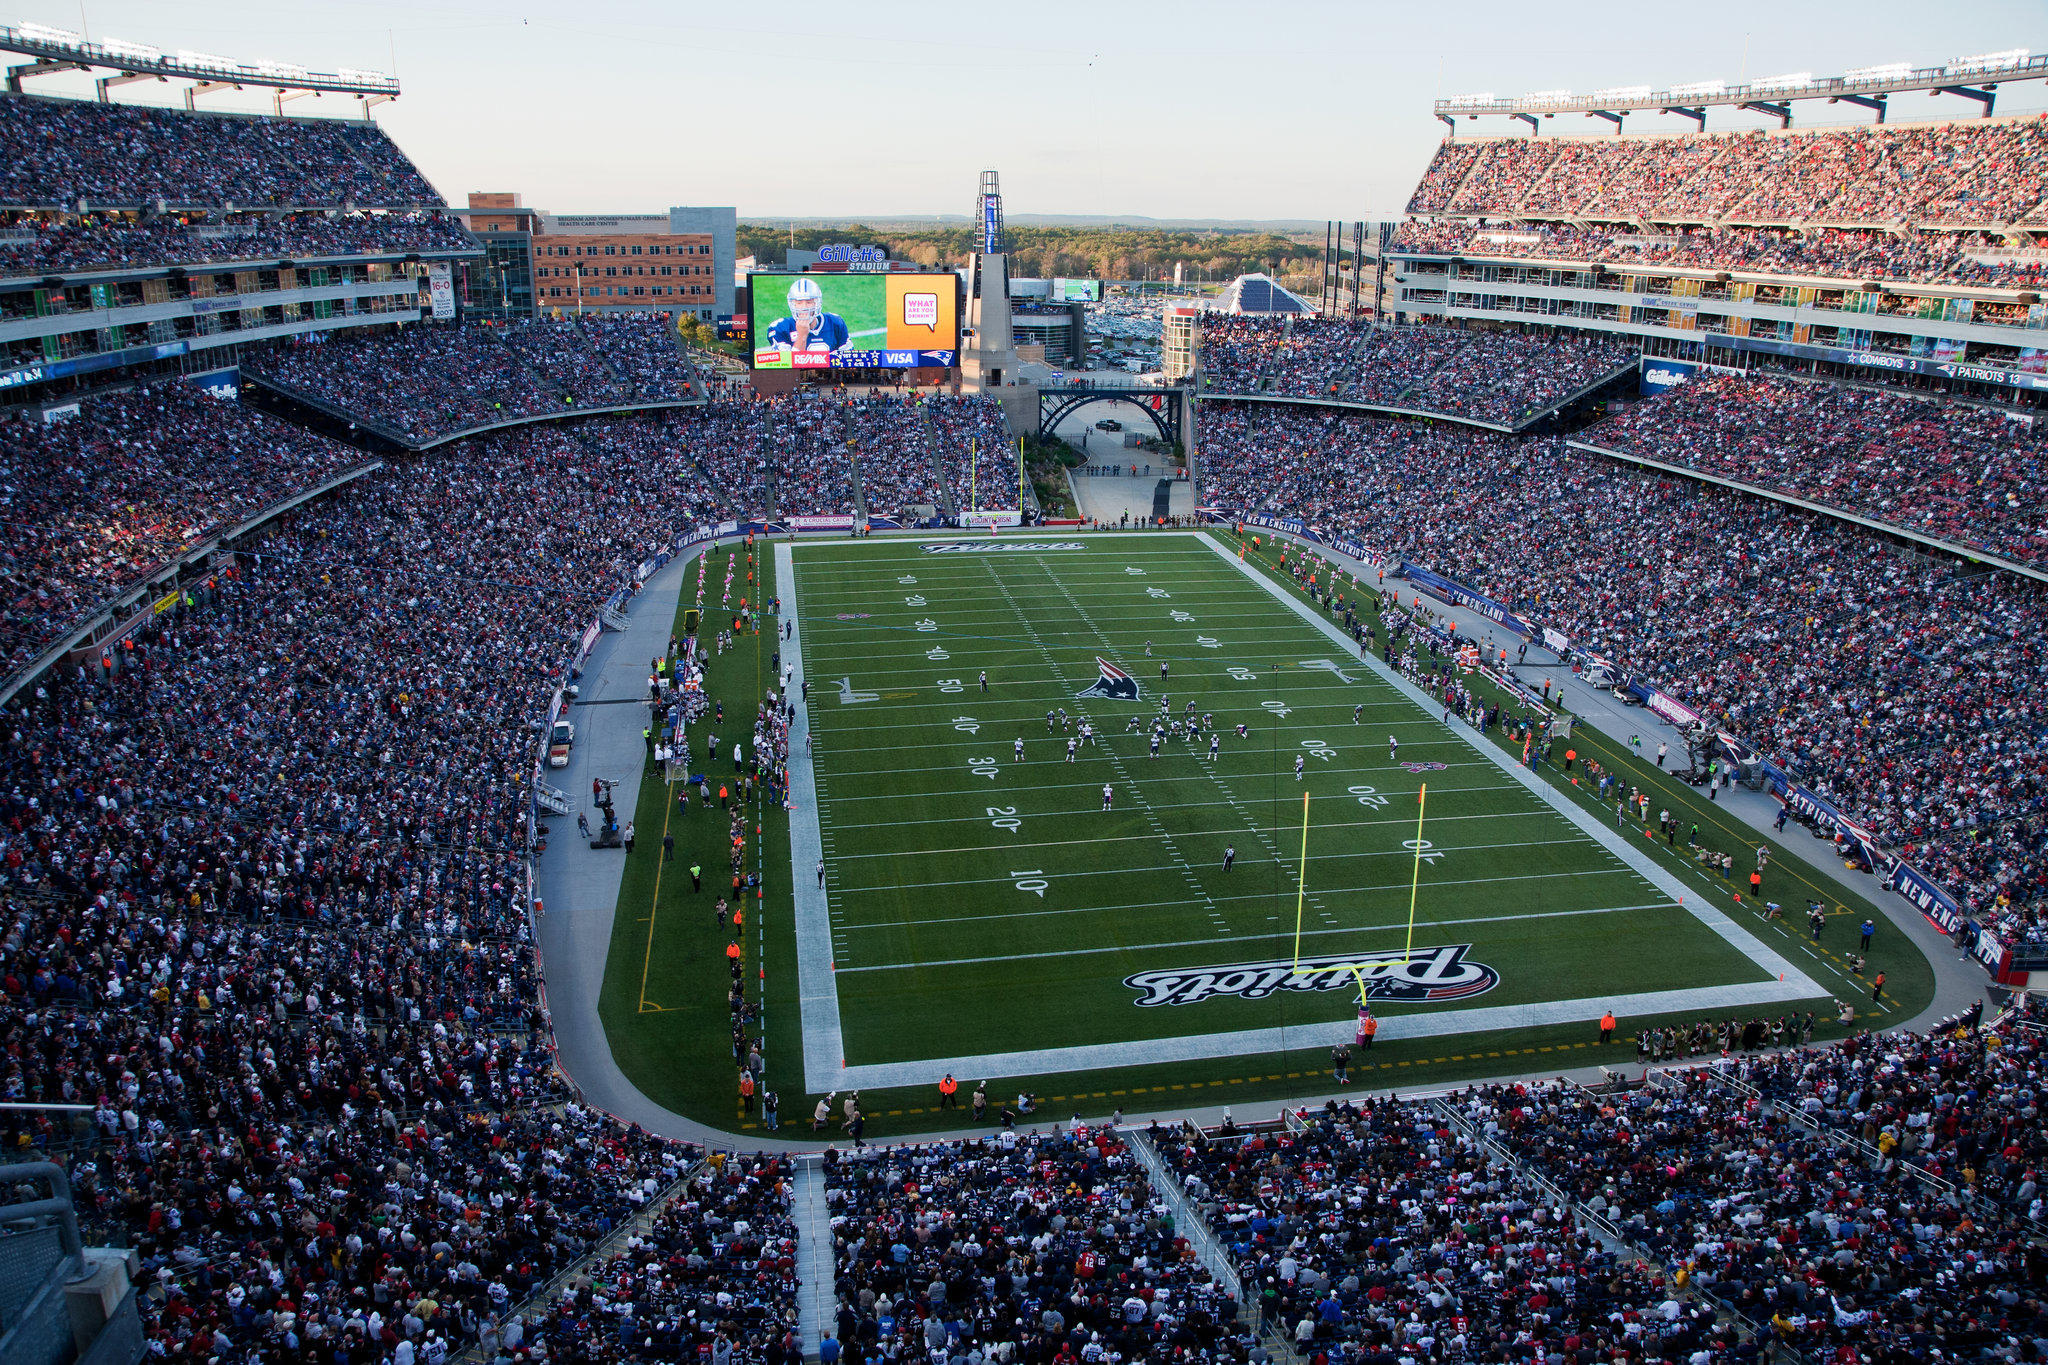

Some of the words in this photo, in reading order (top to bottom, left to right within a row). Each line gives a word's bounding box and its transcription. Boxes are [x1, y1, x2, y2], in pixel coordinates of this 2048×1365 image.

[819, 244, 886, 262] Gillette
[849, 262, 891, 270] STADIUM
[432, 281, 450, 290] 16-0
[794, 354, 827, 364] RE/MAX
[831, 358, 840, 366] 13
[873, 358, 878, 366] 3
[886, 353, 914, 364] VISA
[1859, 354, 1904, 368] COWBOYS
[1910, 360, 1916, 370] 3
[1957, 366, 2005, 383] PATRIOTS
[2009, 373, 2020, 384] 13
[1245, 516, 1268, 526] NEW
[1268, 518, 1302, 533] ENGLAND
[1334, 540, 1370, 562] PATRIOTS
[1470, 598, 1504, 622] ENGLAND
[1226, 667, 1257, 681] 50
[936, 678, 964, 693] 50
[952, 716, 980, 731] 40
[1301, 740, 1337, 757] 30
[968, 756, 999, 775] 30
[1347, 785, 1389, 806] 20
[986, 806, 1022, 828] 20
[1402, 839, 1445, 858] 10
[1010, 869, 1049, 891] 10
[1900, 876, 1934, 910] NEW
[1123, 944, 1500, 1008] Patriots
[1084, 1257, 1094, 1268] 12
[1097, 1257, 1106, 1265] 12
